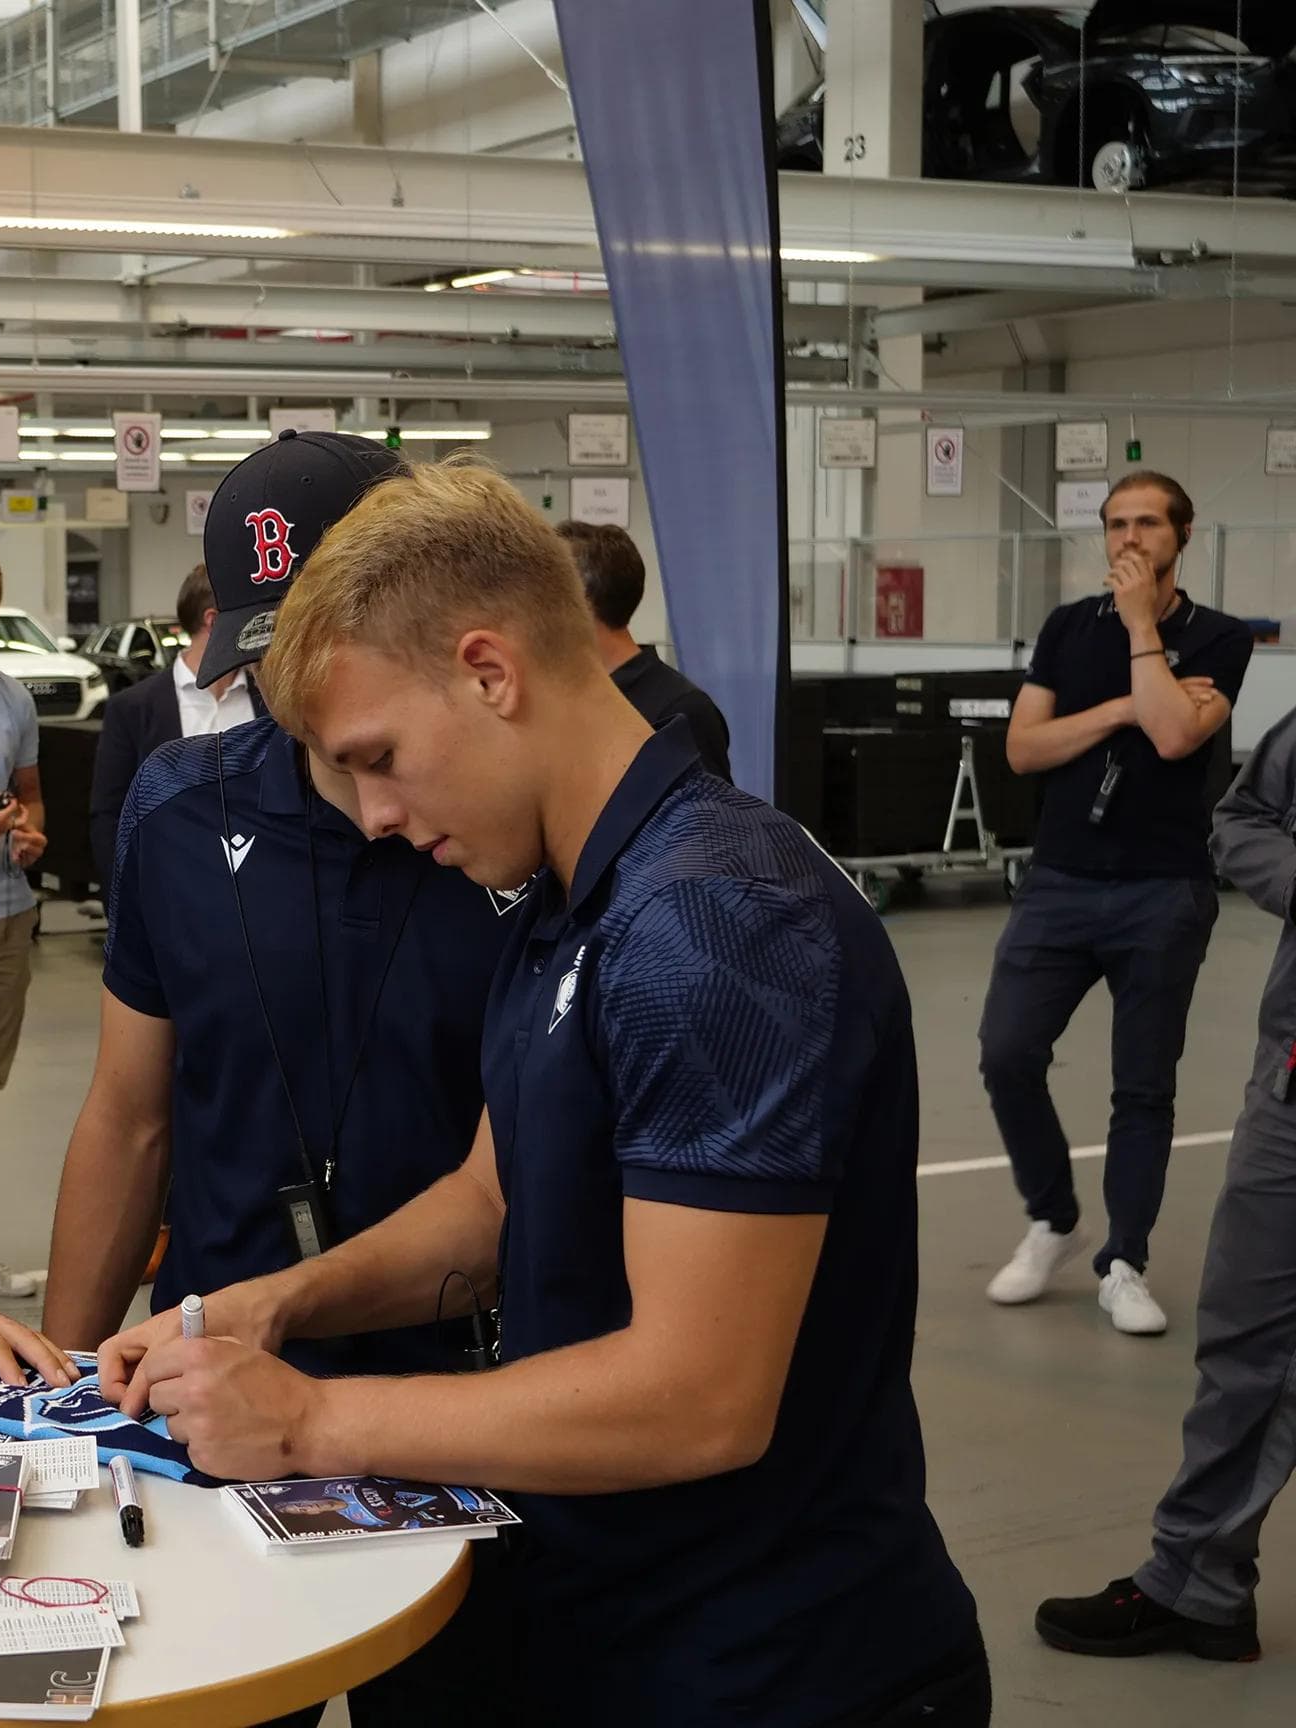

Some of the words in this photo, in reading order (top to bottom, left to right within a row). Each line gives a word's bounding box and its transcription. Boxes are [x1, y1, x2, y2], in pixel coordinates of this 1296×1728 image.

[843, 134, 866, 163] 23
[245, 508, 299, 584] B
[292, 1530, 325, 1539] LEON
